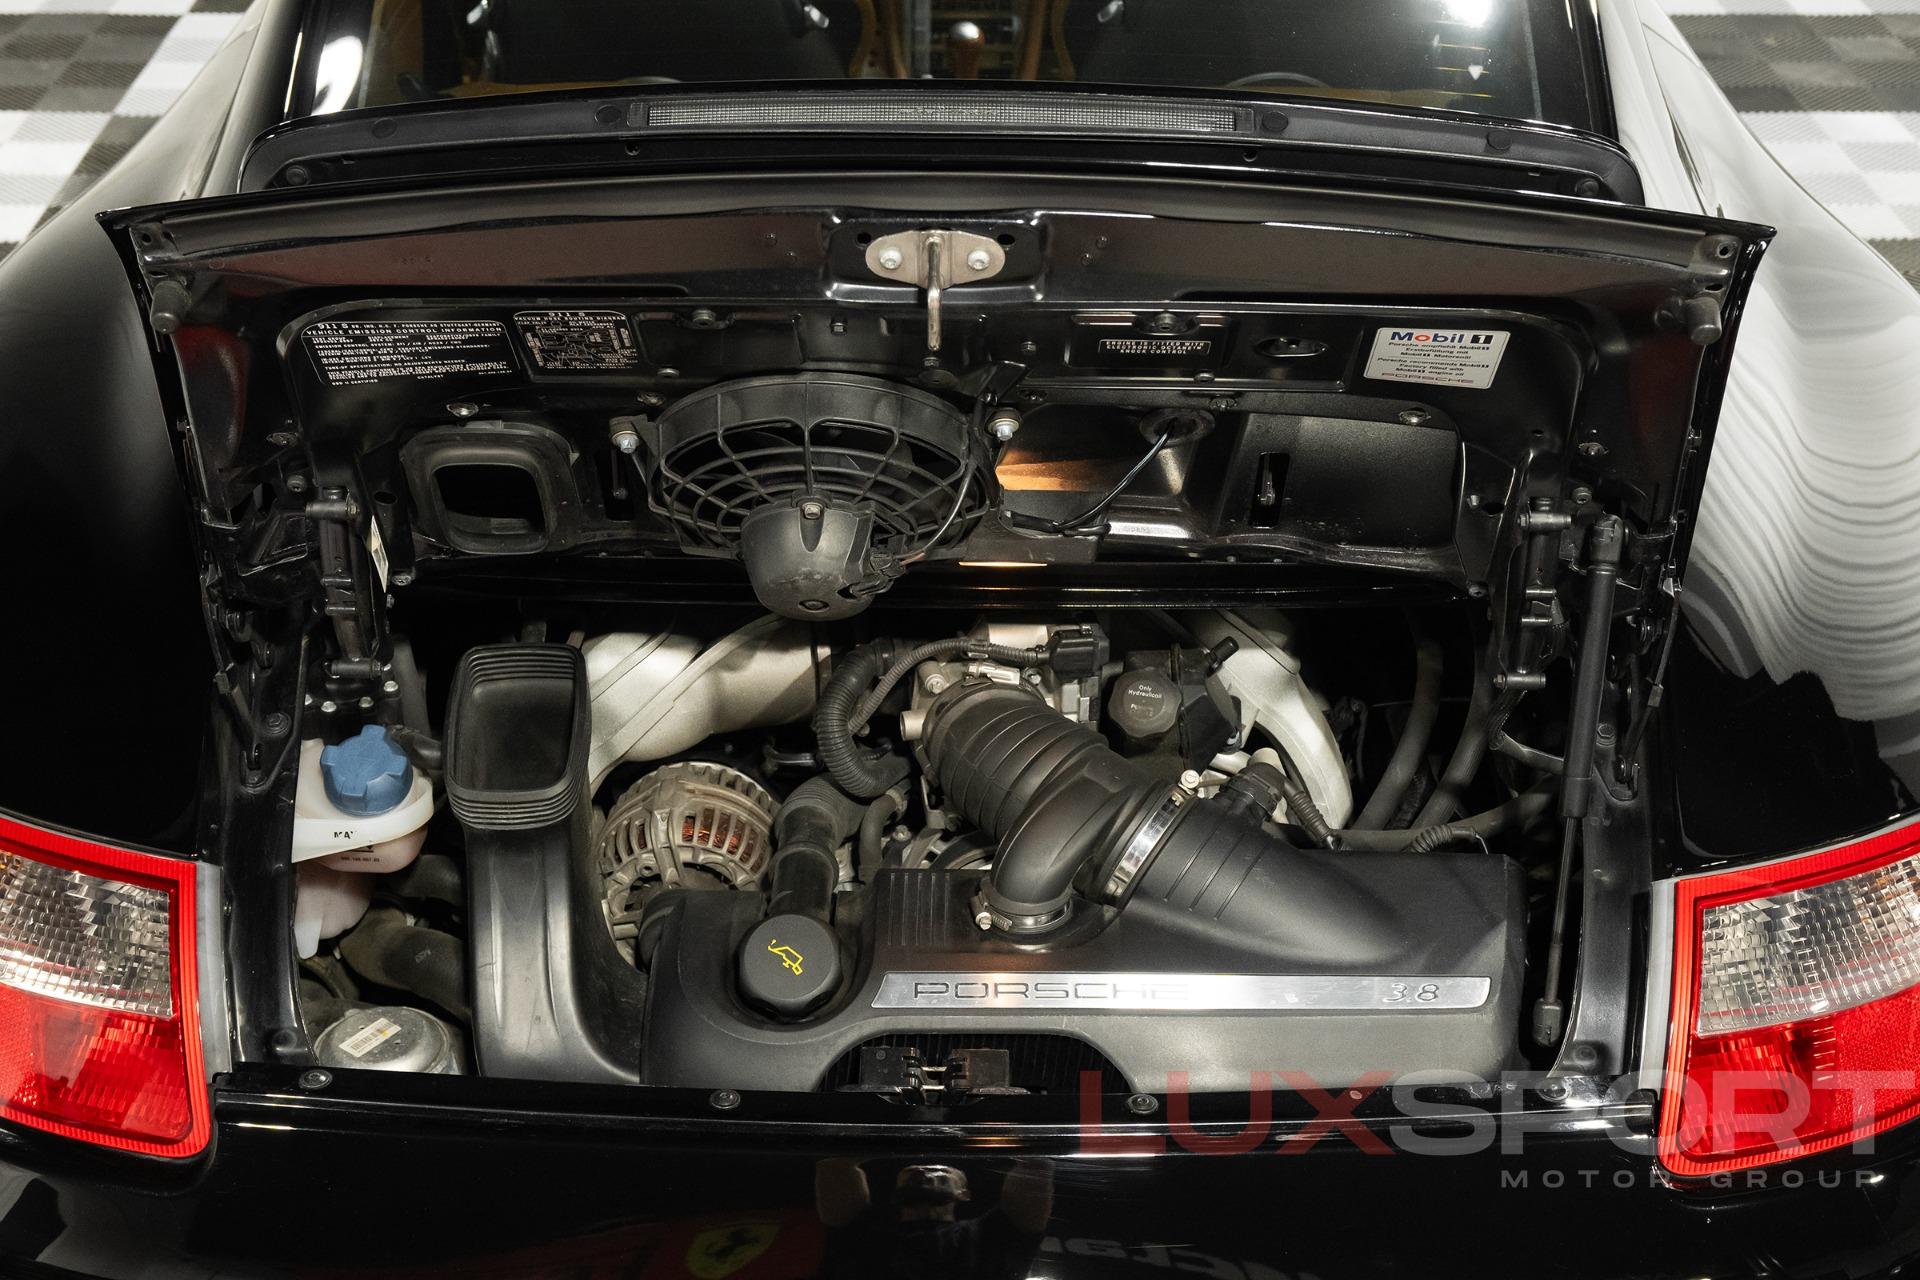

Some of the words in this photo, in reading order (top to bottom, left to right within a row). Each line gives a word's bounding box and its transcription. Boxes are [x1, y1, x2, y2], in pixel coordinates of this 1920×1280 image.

[1390, 331, 1465, 343] Mobil
[1381, 372, 1474, 384] PORSCHE
[913, 982, 1190, 1000] PORSCHE
